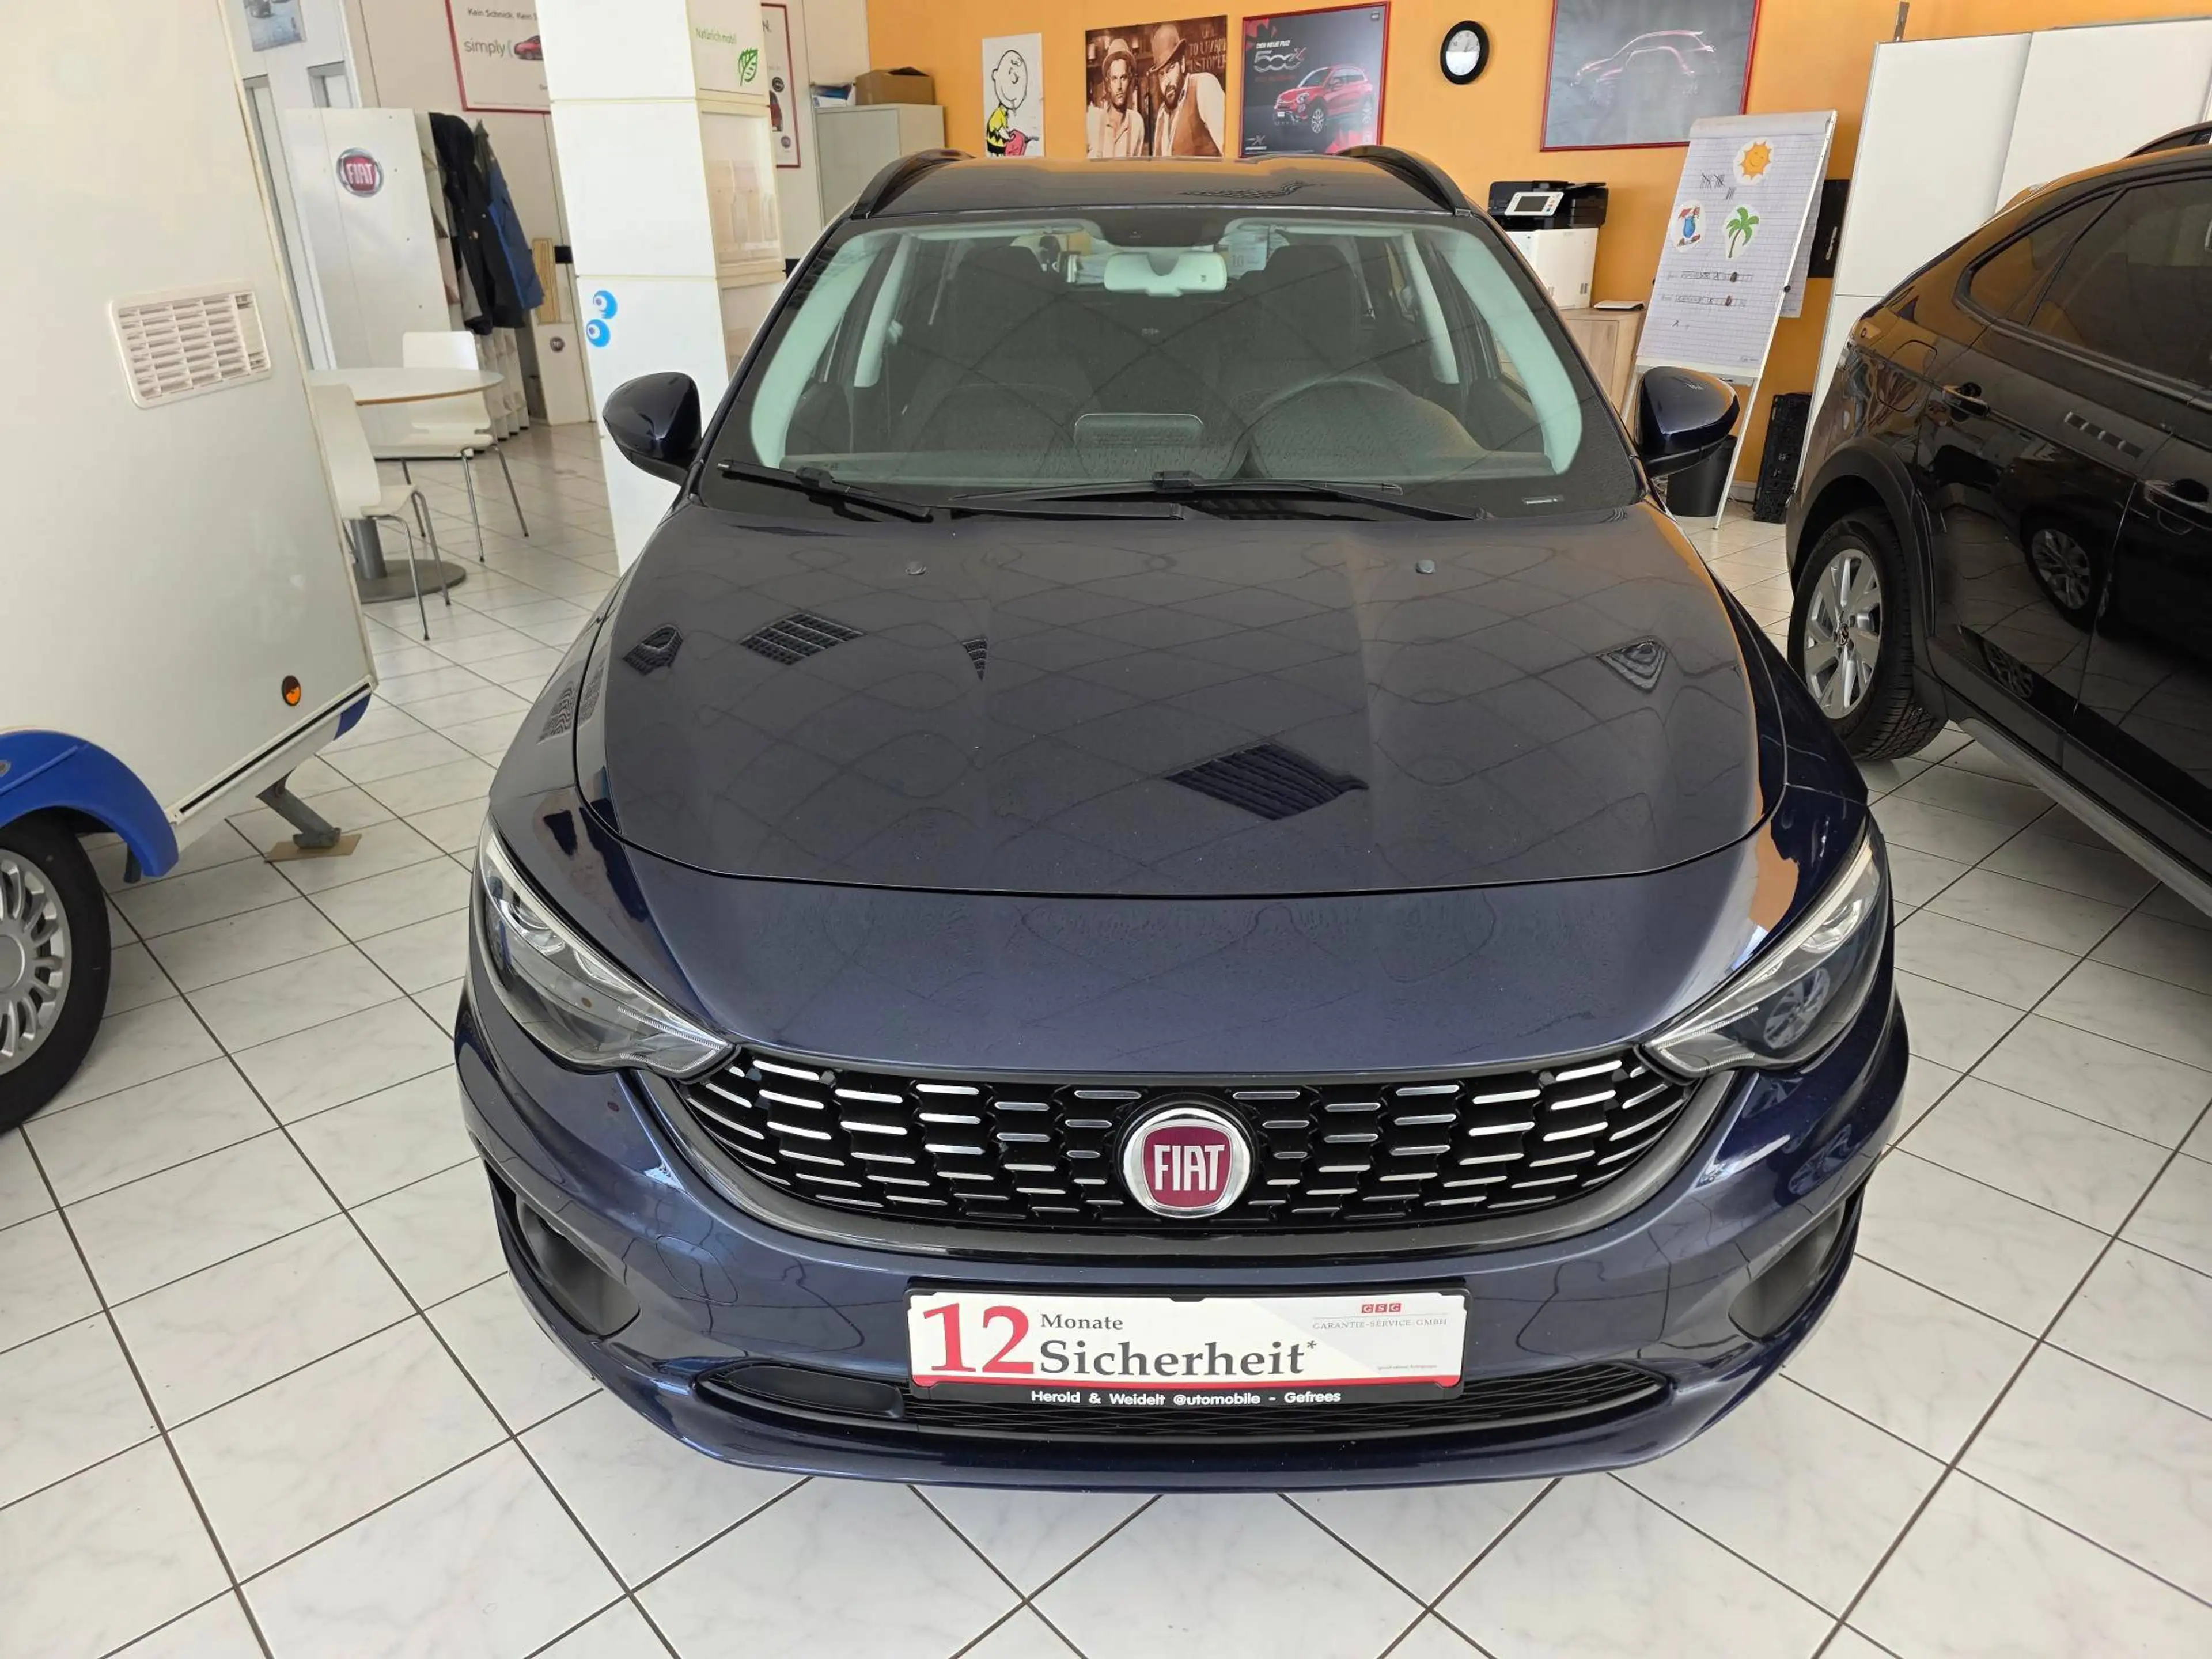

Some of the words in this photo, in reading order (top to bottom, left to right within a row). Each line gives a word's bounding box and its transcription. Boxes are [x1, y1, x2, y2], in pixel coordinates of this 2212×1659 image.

[464, 38, 505, 57] simply
[346, 163, 373, 185] FIAT
[1154, 1145, 1225, 1191] FIAT
[1362, 1303, 1402, 1314] GSG
[1041, 1313, 1123, 1330] Monate
[1312, 1319, 1411, 1330] GARANTIE-SERVICE
[1416, 1317, 1448, 1326] GMBH
[923, 1303, 1034, 1374] 12
[1031, 1390, 1080, 1404] Herold
[1089, 1392, 1101, 1404] &
[1109, 1393, 1165, 1406] Weidelt
[1173, 1392, 1260, 1406] @utomobile
[1284, 1391, 1342, 1404] Gefrees
